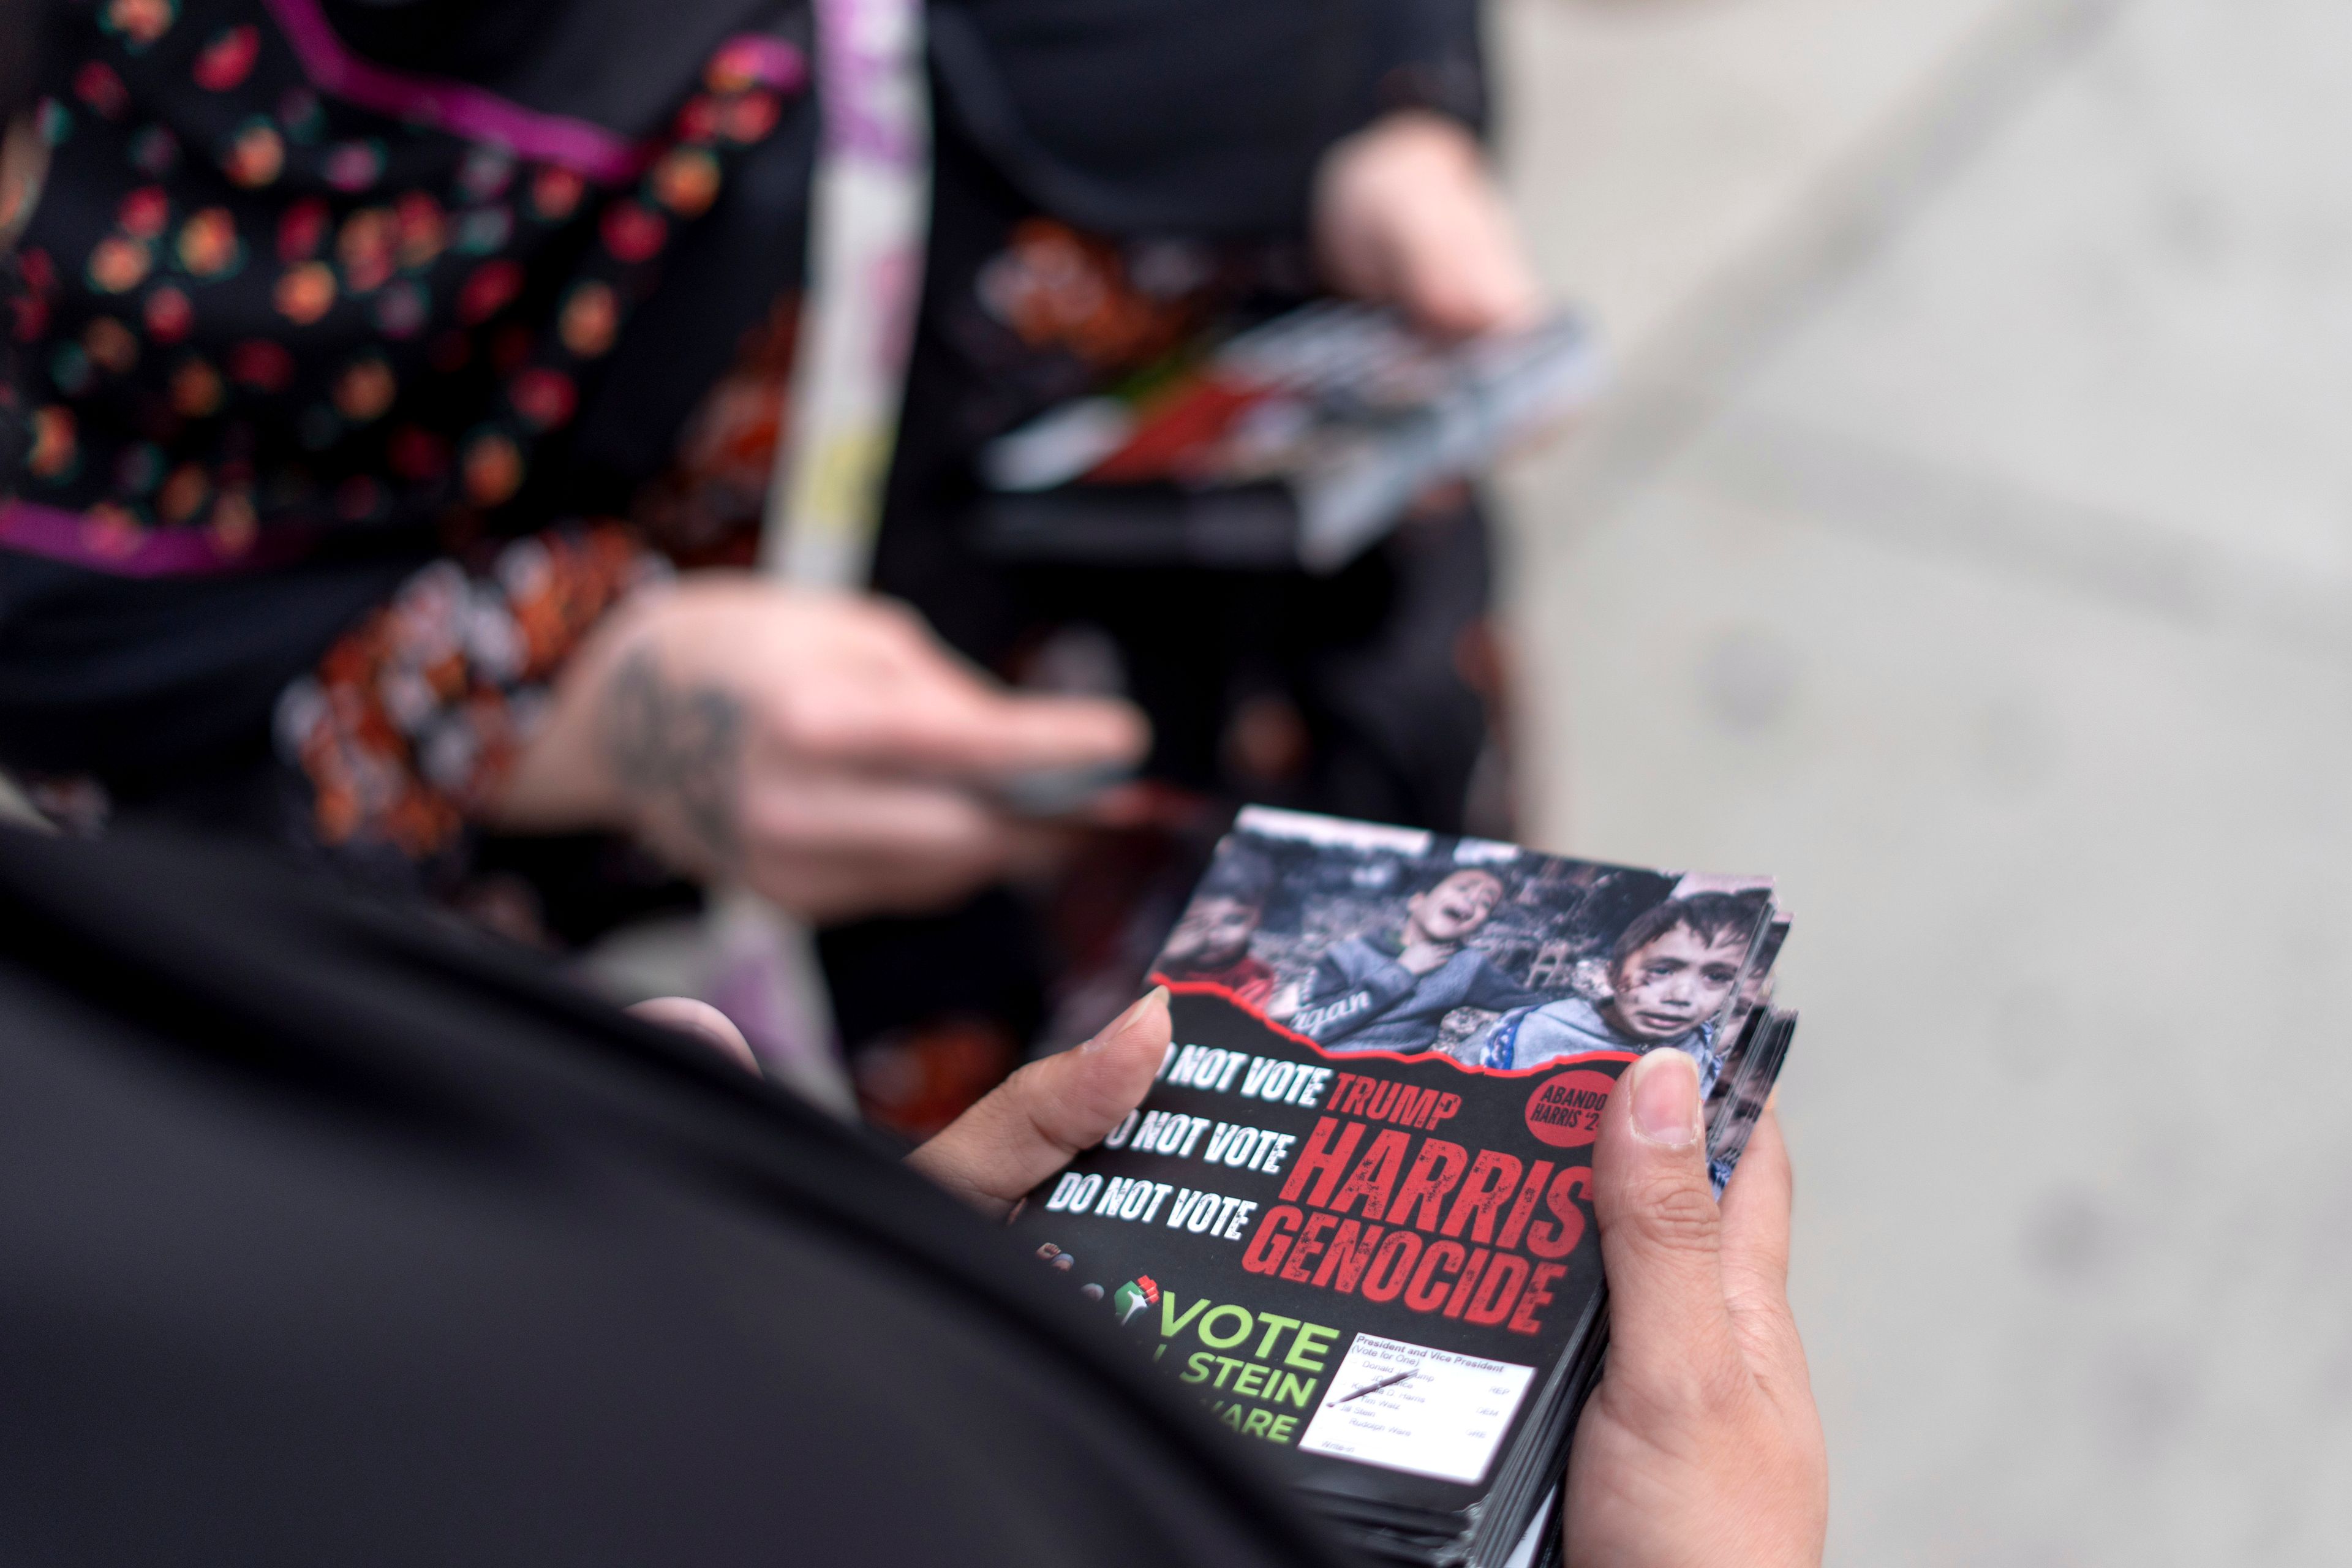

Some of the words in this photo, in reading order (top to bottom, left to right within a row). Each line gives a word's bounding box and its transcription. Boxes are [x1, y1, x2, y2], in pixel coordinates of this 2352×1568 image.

[1167, 1044, 1248, 1093] NOT
[1241, 1056, 1332, 1107] VOTE
[1326, 1072, 1462, 1131] TRUMP
[1540, 1085, 1608, 1111] ABANDO
[1530, 1103, 1581, 1128] HARRIS
[1585, 1112, 1599, 1131] '2
[1130, 1110, 1211, 1157] NOT
[1204, 1121, 1297, 1174] VOTE
[1278, 1116, 1593, 1258] HARRIS
[1046, 1171, 1103, 1214] DO
[1094, 1176, 1172, 1223] NOT
[1167, 1188, 1257, 1240] VOTE
[1242, 1204, 1568, 1335] GENOCIDE
[1161, 1290, 1340, 1372] VOTE
[1351, 1344, 1378, 1357] (Vote
[1379, 1350, 1394, 1360] for
[1395, 1354, 1420, 1368] One)
[1356, 1335, 1406, 1353] President
[1408, 1346, 1428, 1357] and
[1430, 1351, 1452, 1363] Vice
[1453, 1356, 1505, 1373] President
[1362, 1360, 1395, 1374] Donald
[1415, 1372, 1435, 1382] ump
[1179, 1351, 1317, 1409] STEIN
[1212, 1400, 1300, 1442] ARE
